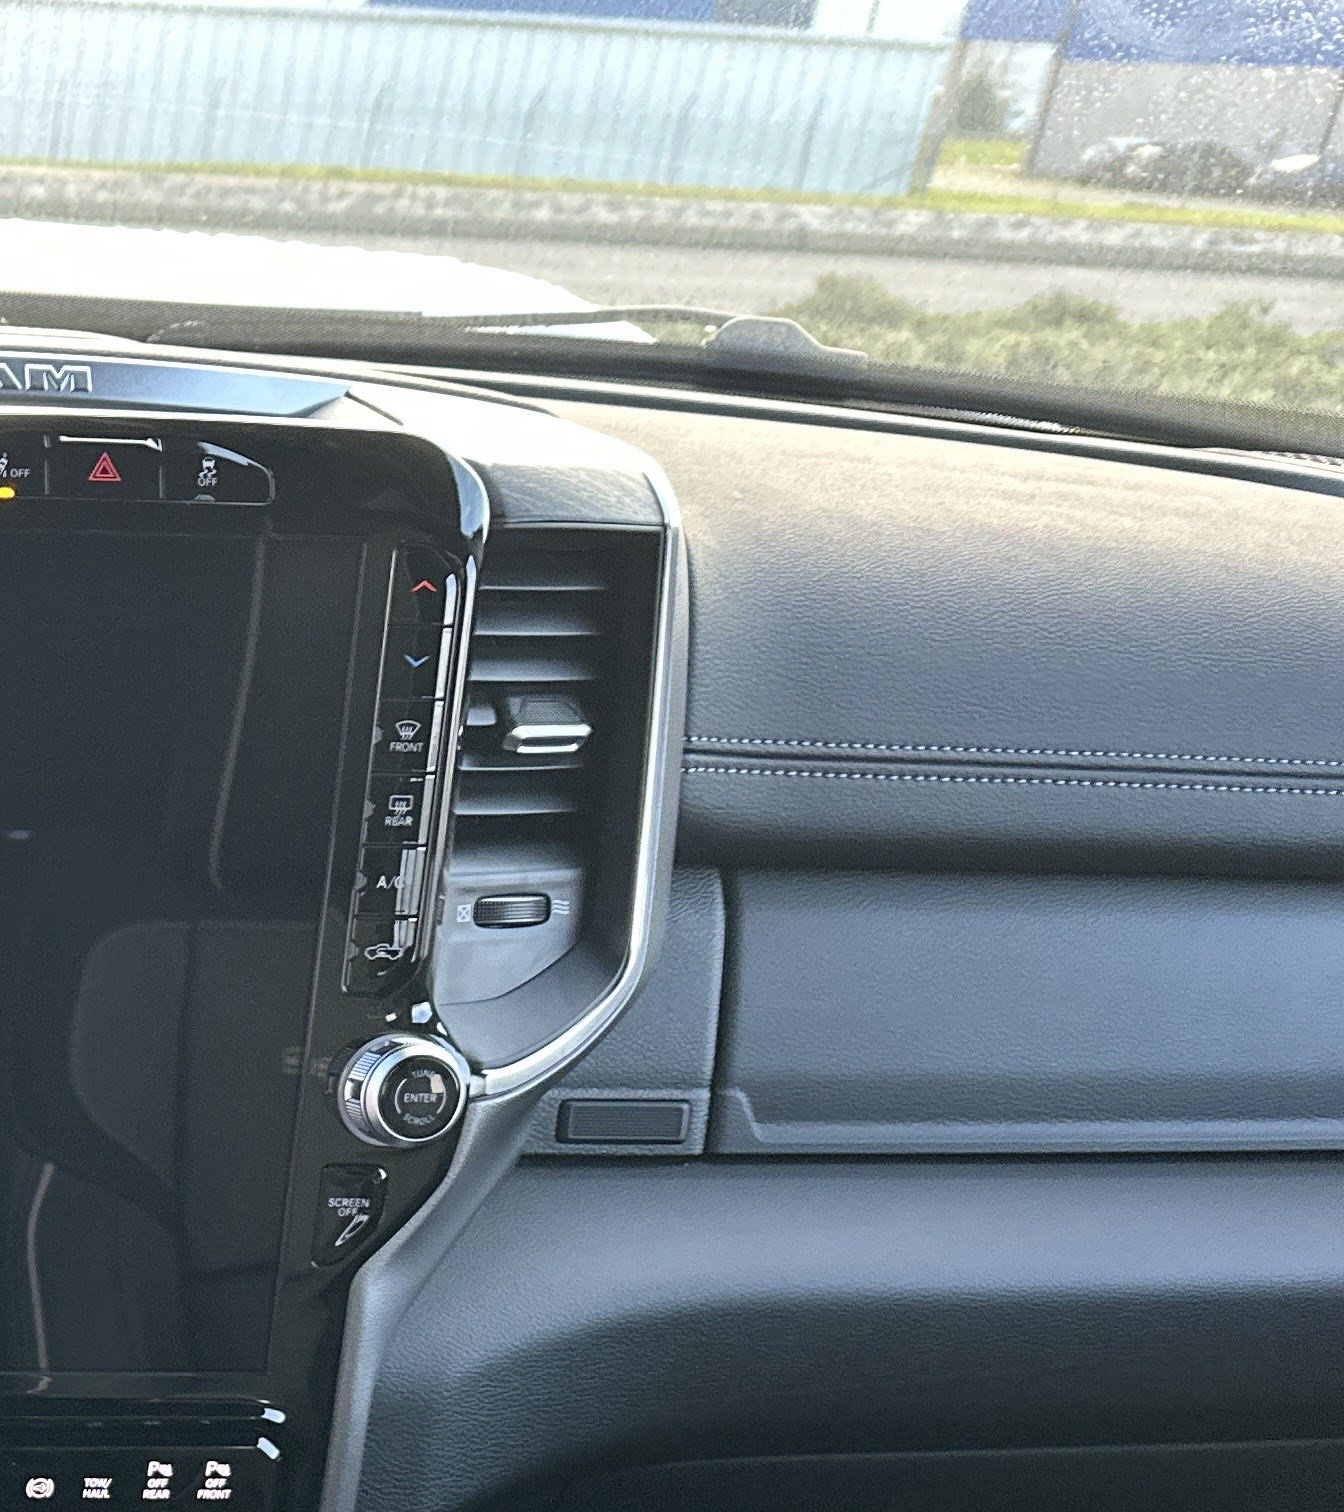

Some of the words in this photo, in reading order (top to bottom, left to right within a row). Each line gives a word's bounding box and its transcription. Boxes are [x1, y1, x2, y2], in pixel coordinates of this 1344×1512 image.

[10, 467, 31, 479] OFF
[197, 476, 218, 487] OFF
[389, 741, 424, 753] FRONT
[384, 815, 413, 827] REAR
[403, 1092, 437, 1103] ENTER
[327, 1197, 370, 1208] SCREEN
[337, 1207, 359, 1217] OFF
[84, 1477, 112, 1488] TOW/
[147, 1477, 169, 1488] OFF
[205, 1477, 227, 1488] OFF
[82, 1489, 111, 1499] HAUL
[142, 1489, 171, 1499] REAR
[197, 1489, 232, 1499] FRONT
